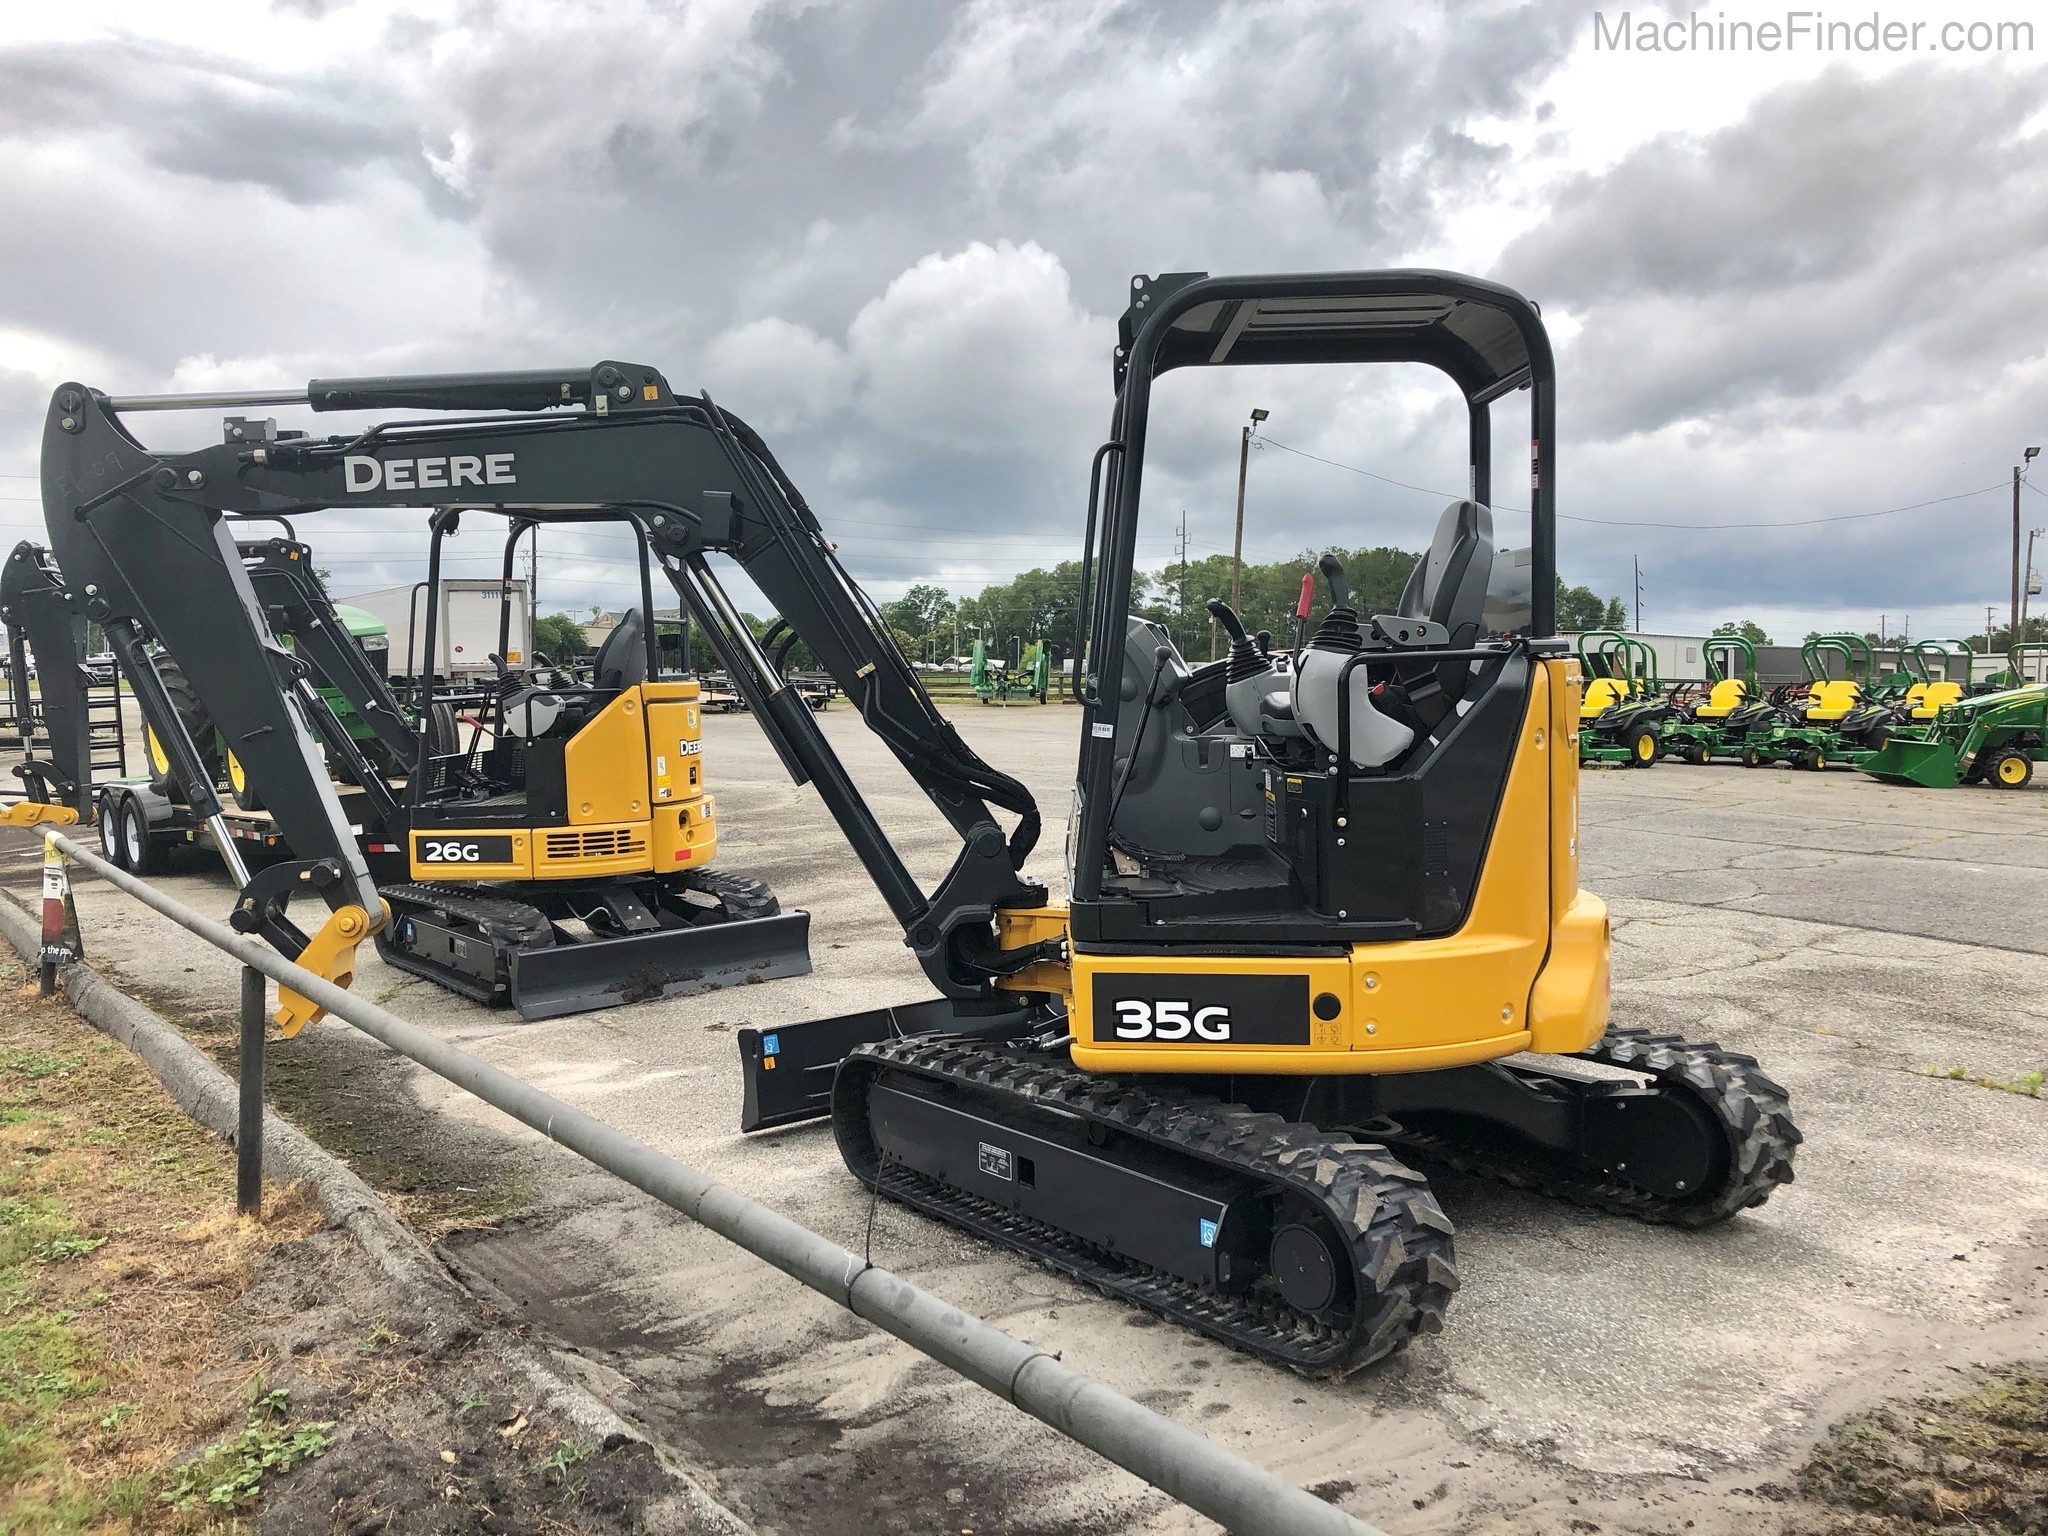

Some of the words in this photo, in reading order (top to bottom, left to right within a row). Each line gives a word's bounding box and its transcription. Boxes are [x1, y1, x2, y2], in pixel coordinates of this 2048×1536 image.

[344, 453, 517, 493] DEERE
[425, 842, 480, 862] 26G
[47, 945, 60, 955] the
[1115, 1000, 1231, 1041] 35G
